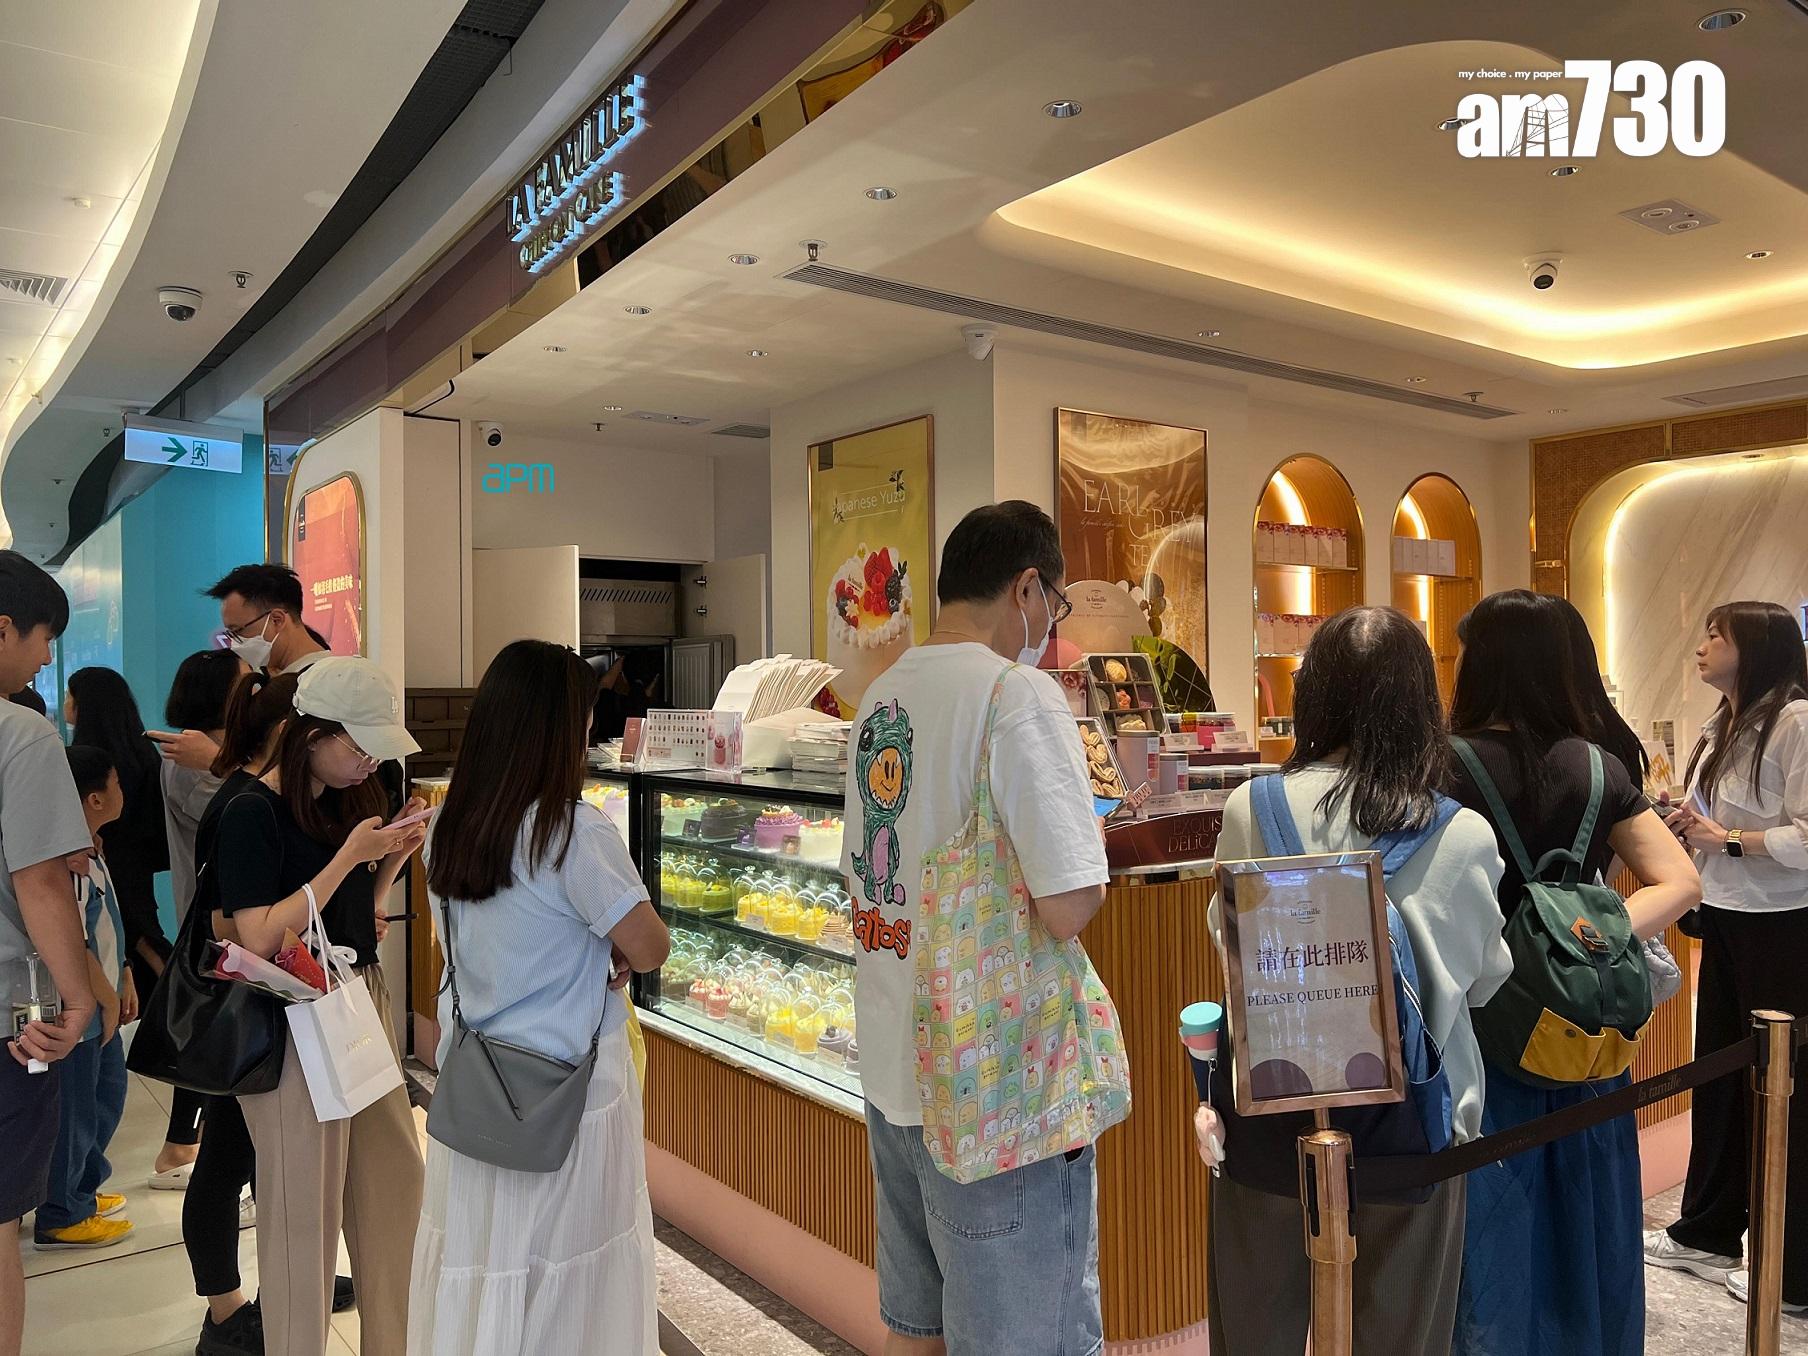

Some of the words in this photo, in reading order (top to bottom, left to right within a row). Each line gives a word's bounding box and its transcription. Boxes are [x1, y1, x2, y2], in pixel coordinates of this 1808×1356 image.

[1083, 479, 1148, 517] EARL
[1128, 507, 1197, 543] GREY
[1256, 940, 1369, 972] 請在此排隊
[1247, 992, 1295, 1007] PLEASE
[1297, 987, 1342, 1005] QUEUE
[1344, 984, 1380, 998] HERE
